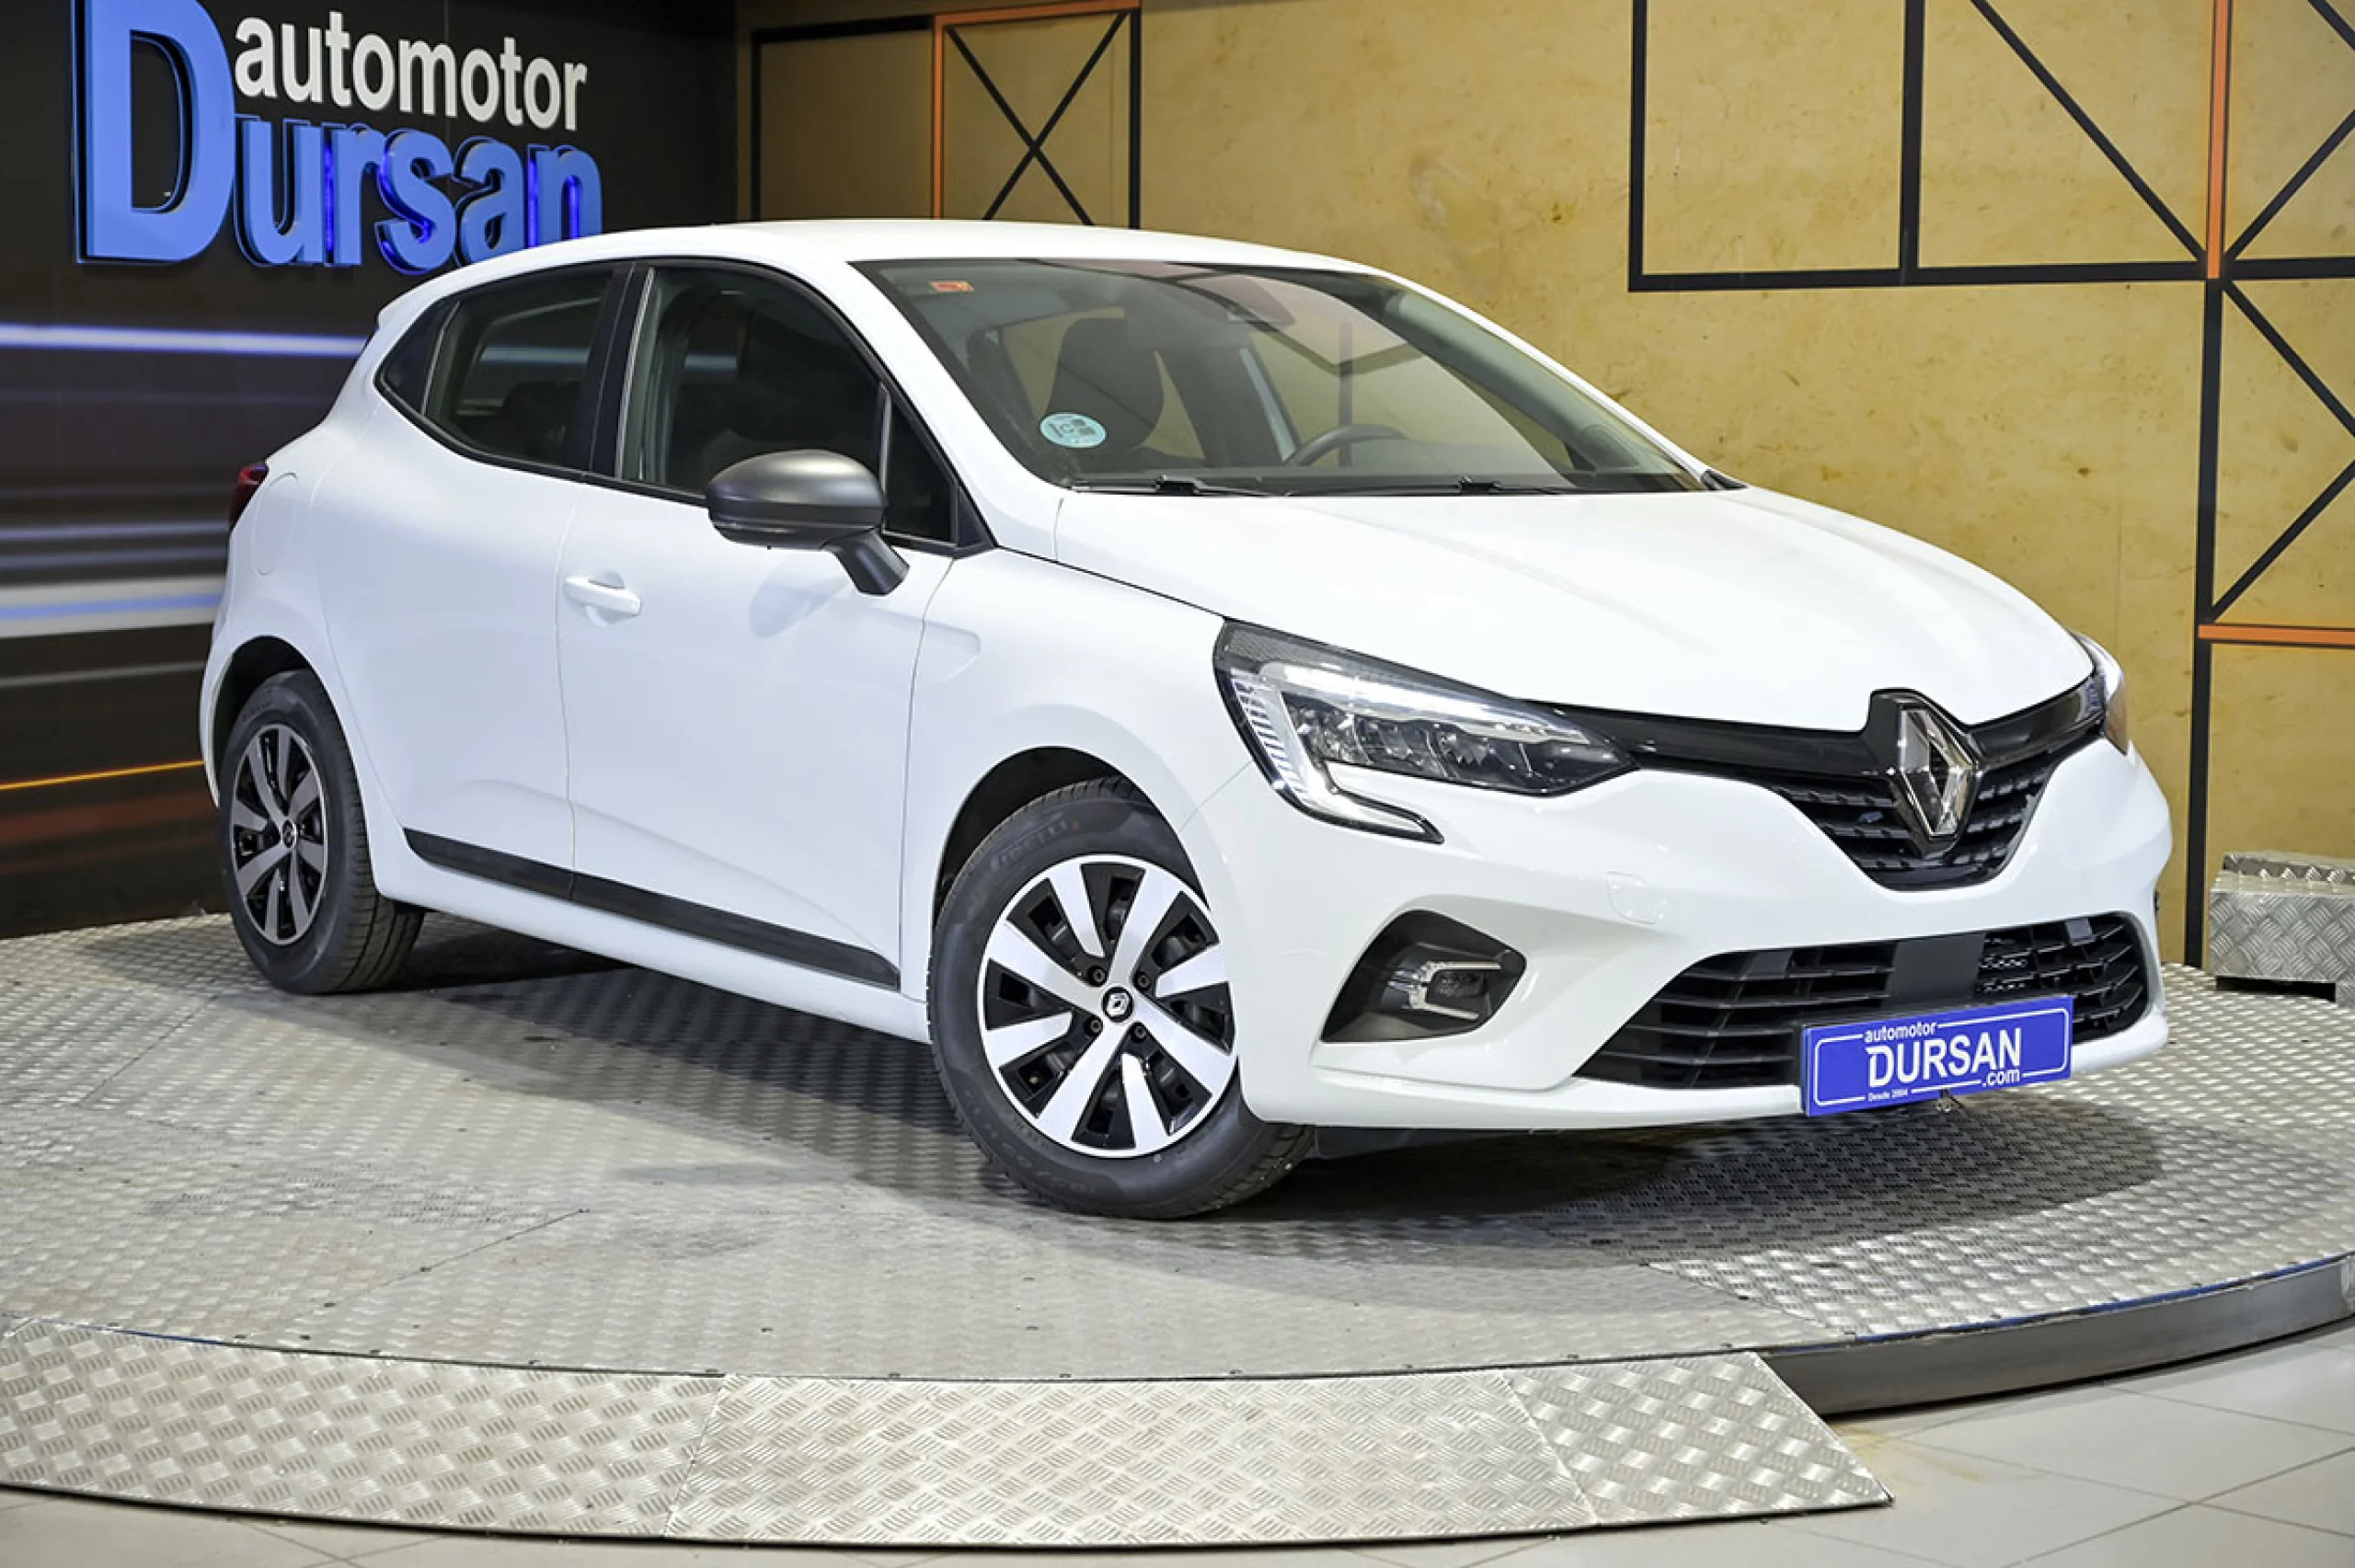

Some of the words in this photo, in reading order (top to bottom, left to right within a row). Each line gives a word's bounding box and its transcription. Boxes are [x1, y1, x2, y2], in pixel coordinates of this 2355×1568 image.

[235, 12, 587, 131] automotor
[75, 0, 603, 274] Dursan
[1865, 1022, 1936, 1043] automotor
[1867, 1027, 2021, 1087] DURSAN
[1982, 1069, 2020, 1086] .com
